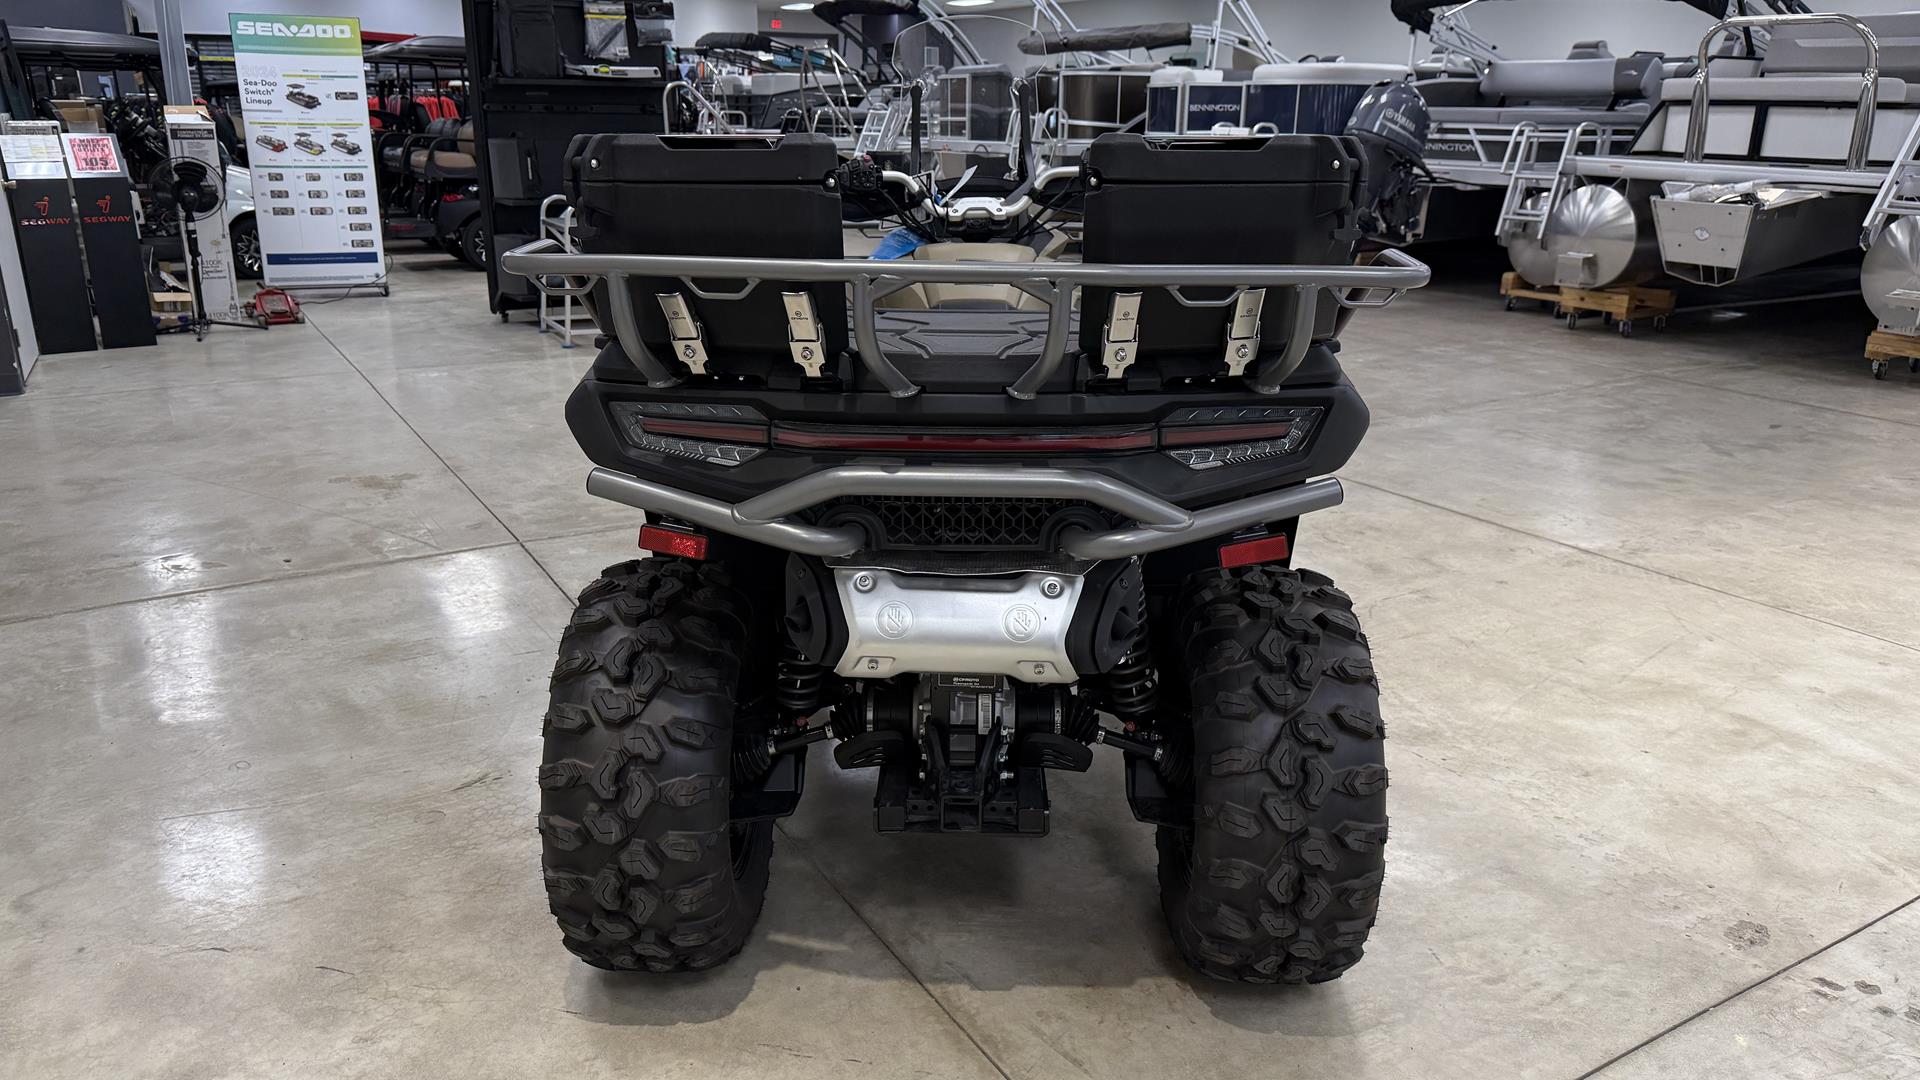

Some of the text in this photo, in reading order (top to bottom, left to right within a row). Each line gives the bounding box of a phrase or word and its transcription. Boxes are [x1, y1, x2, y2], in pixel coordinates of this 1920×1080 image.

[243, 79, 277, 87] Sea-Doo
[245, 97, 272, 106] Lineup
[21, 217, 71, 226] SEGWAY
[82, 215, 131, 224] SEGWAY
